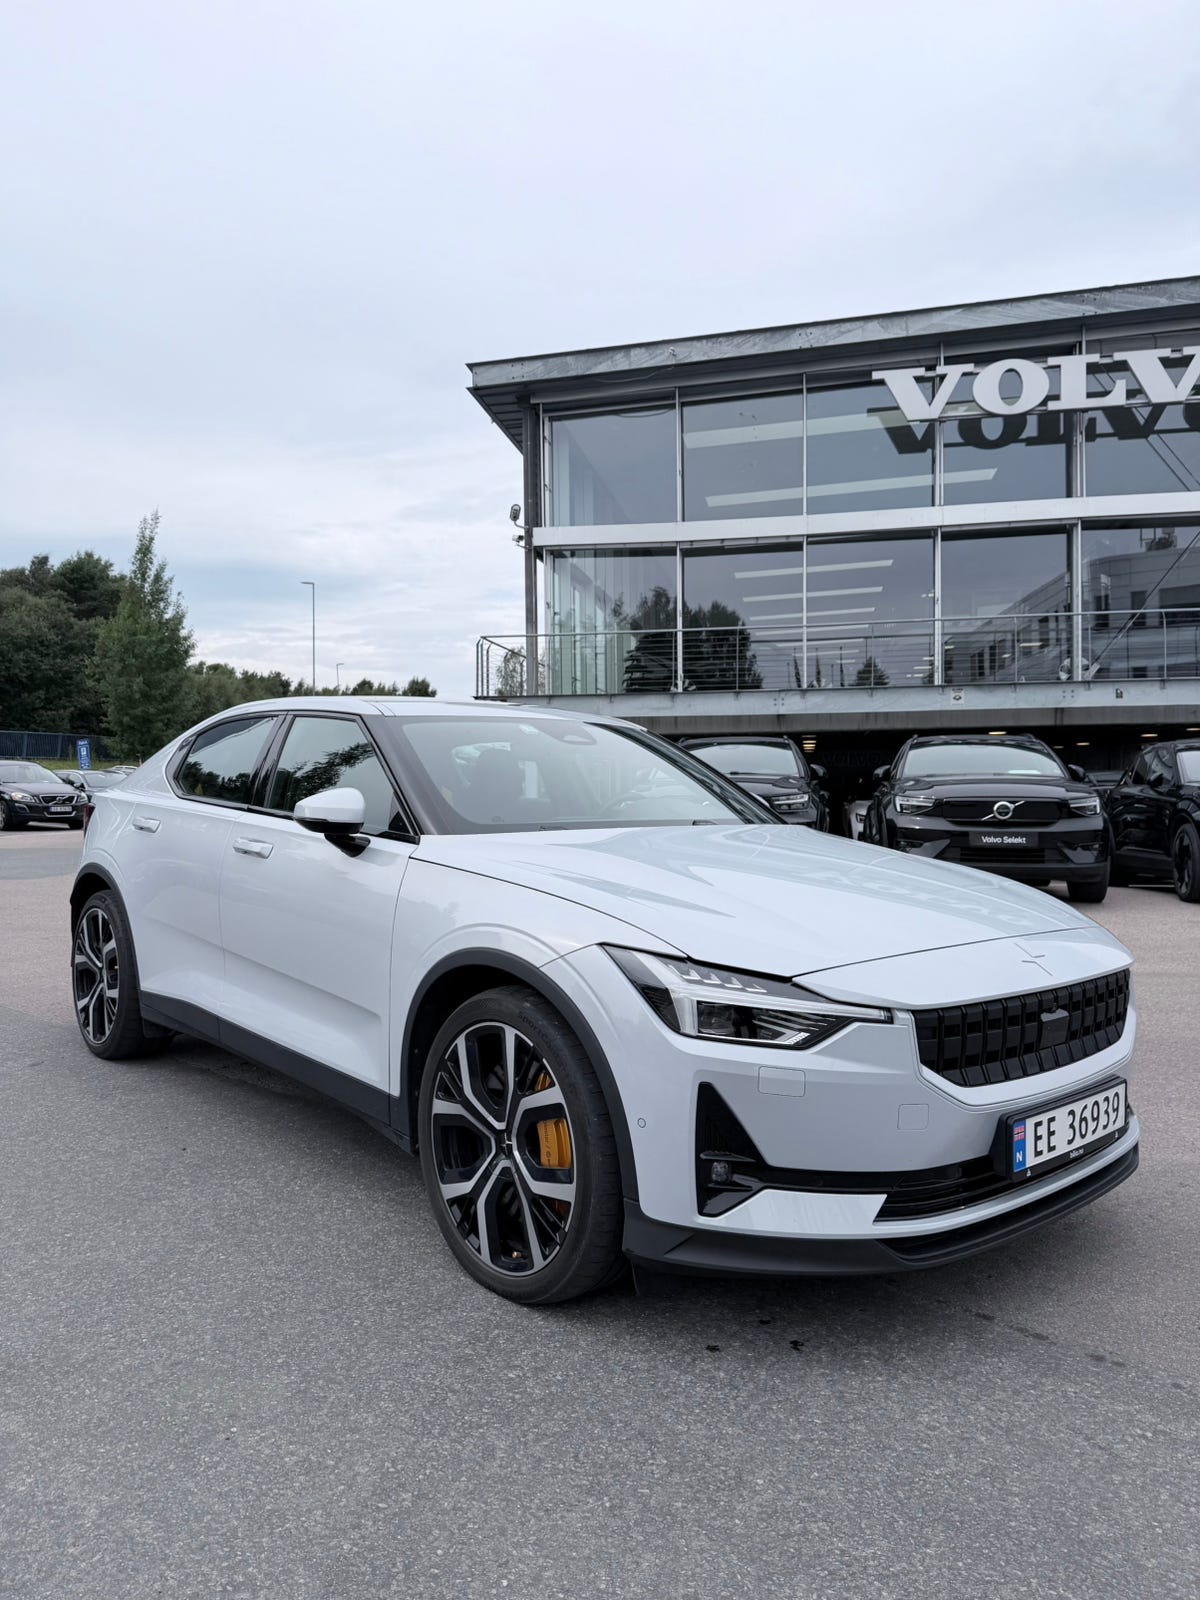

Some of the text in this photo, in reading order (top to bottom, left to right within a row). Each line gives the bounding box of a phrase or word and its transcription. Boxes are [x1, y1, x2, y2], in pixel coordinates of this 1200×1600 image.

[981, 835, 1026, 844] Volvo Selekt
[1034, 1091, 1120, 1157] EE 36939
[1016, 1151, 1023, 1163] N
